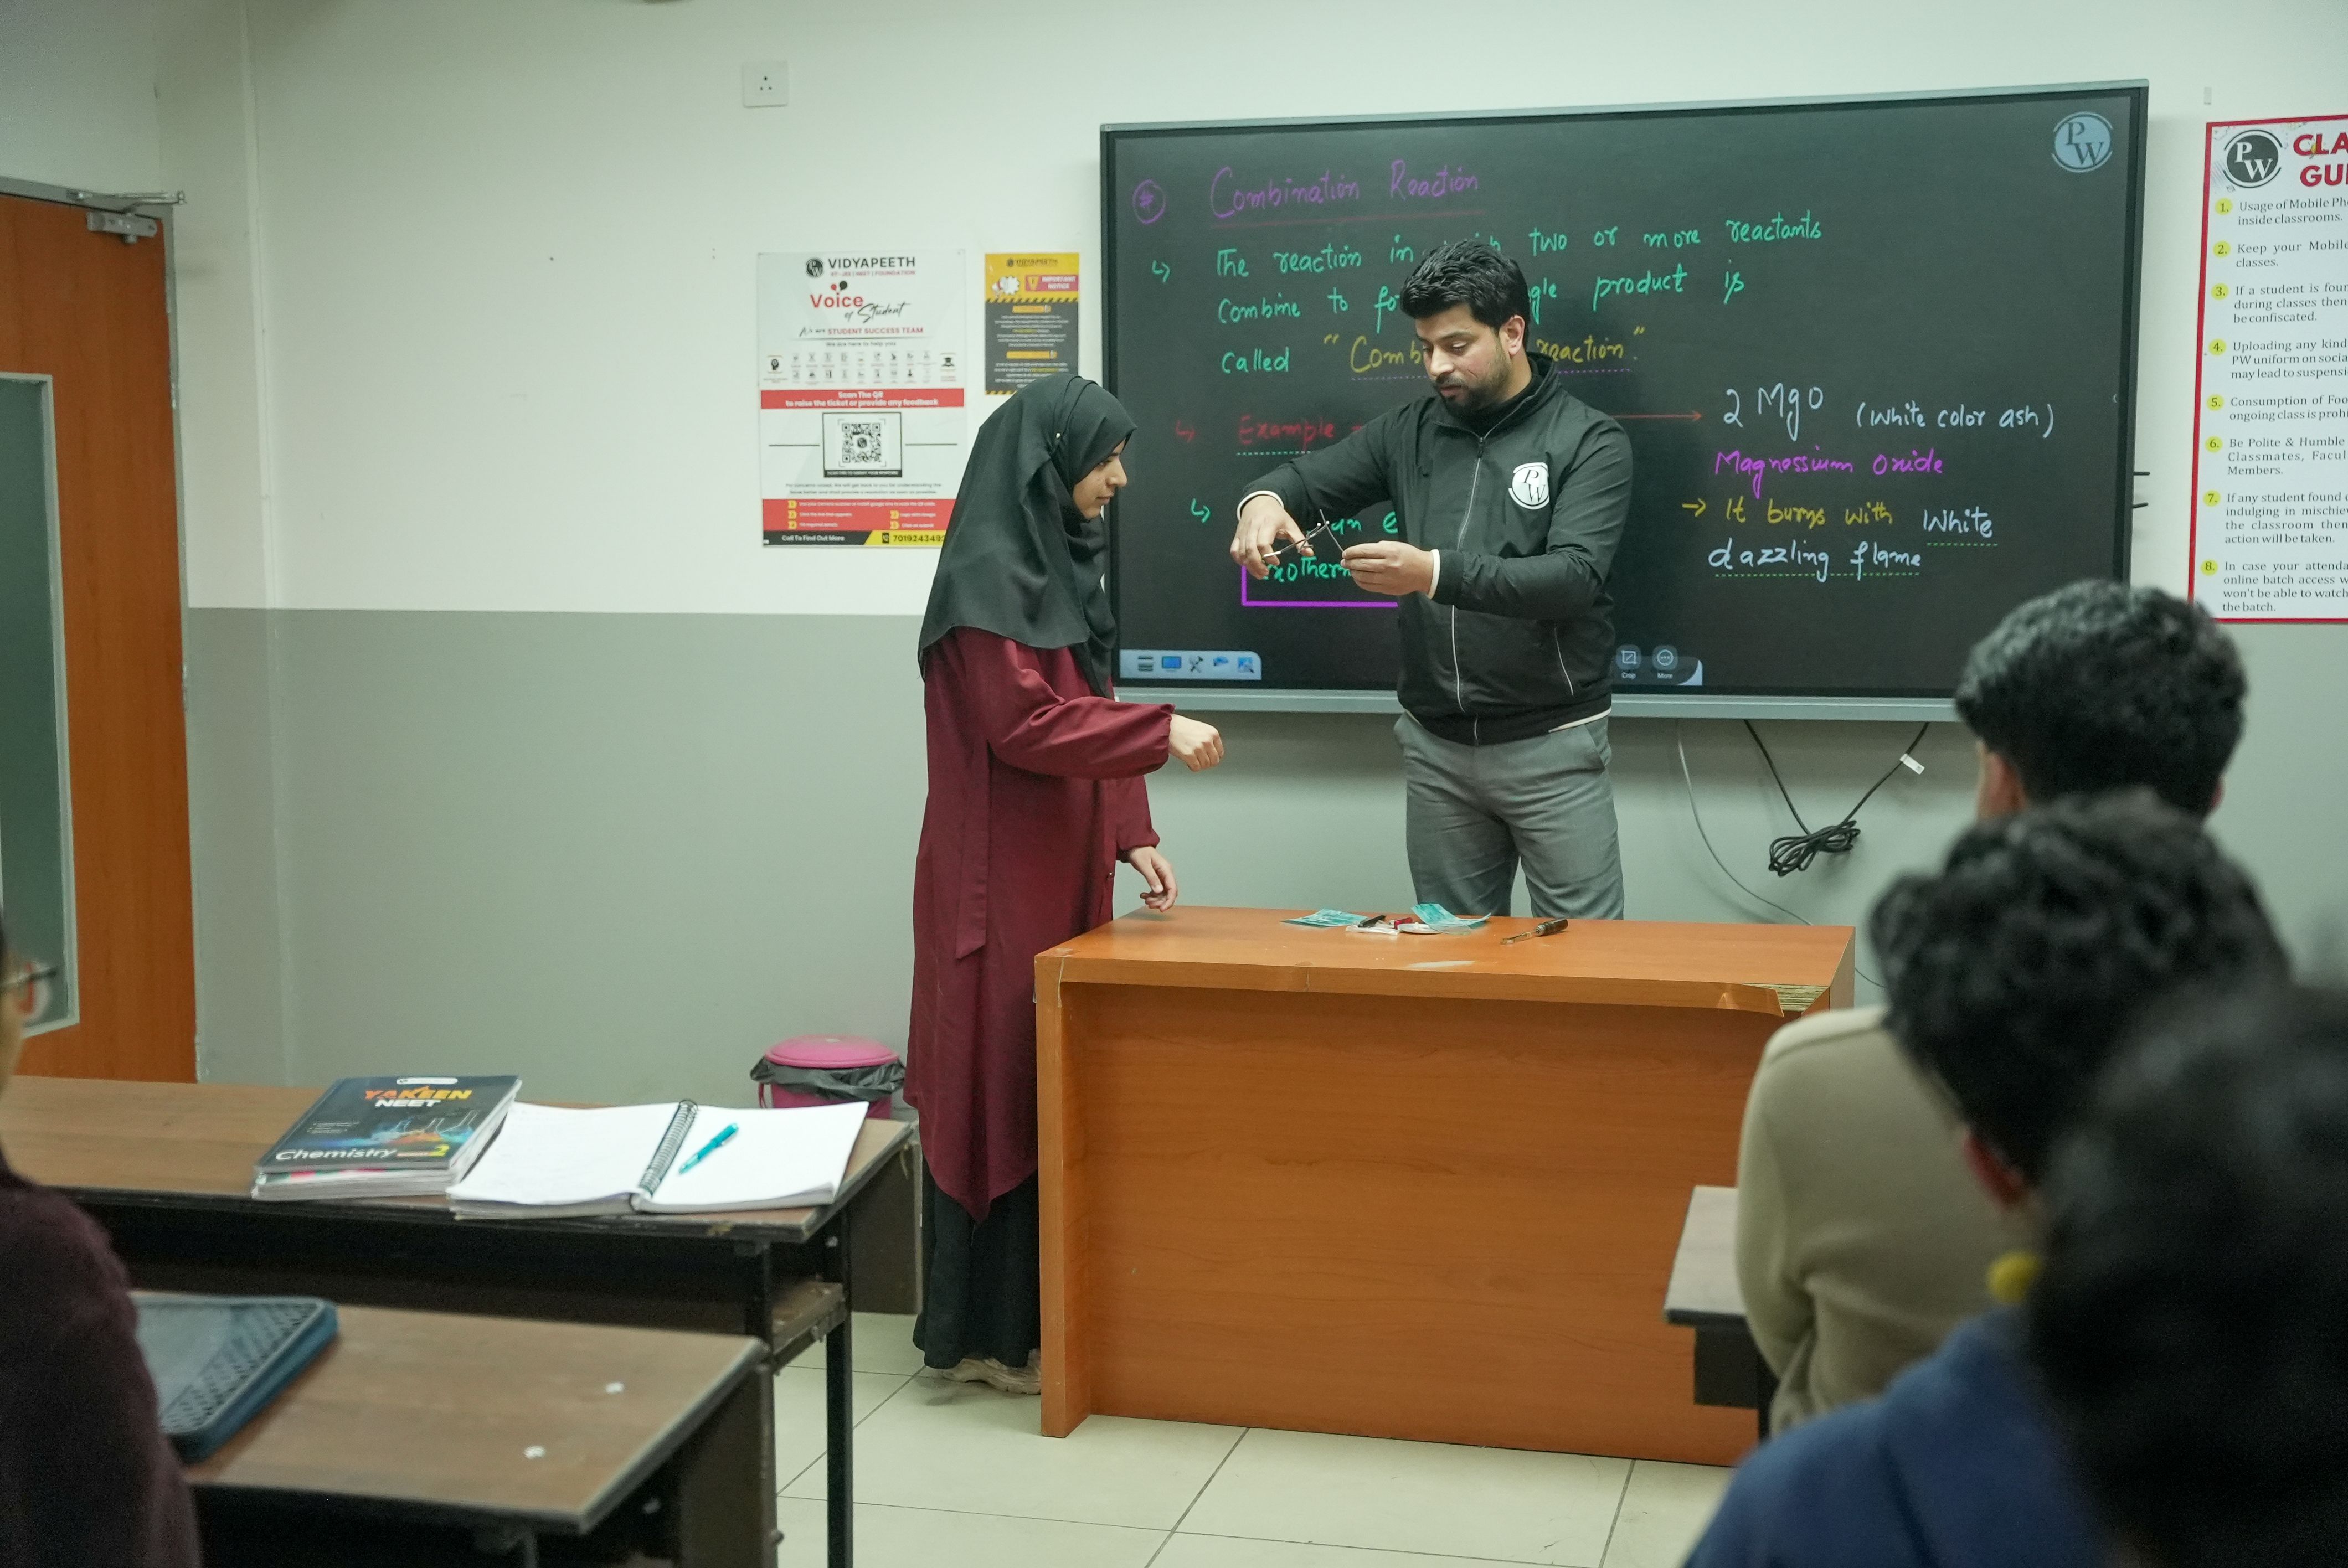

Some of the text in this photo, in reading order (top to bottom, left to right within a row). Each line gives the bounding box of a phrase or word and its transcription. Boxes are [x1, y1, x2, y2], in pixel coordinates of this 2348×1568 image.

[2234, 142, 2273, 180] PW
[1211, 159, 1478, 218] Combination Reaction
[2220, 197, 2348, 213] 1. Usage of Mobile Ph
[2238, 213, 2343, 225] inside classrooms.
[1217, 247, 1249, 277] The
[1273, 243, 1362, 274] reaction
[1389, 234, 1414, 263] in
[1594, 226, 1618, 246] or
[1644, 229, 1701, 249] more
[2217, 244, 2227, 255] 2.
[2238, 244, 2267, 255] Keep
[2273, 243, 2302, 254] your
[828, 257, 916, 269] VIDYAPEETH
[2236, 258, 2278, 267] classes.
[1328, 287, 1349, 313] to
[1592, 263, 1688, 312] product
[2215, 286, 2225, 297] 3.
[2236, 285, 2245, 295] If
[2260, 285, 2304, 295] student
[2310, 283, 2319, 292] is
[810, 292, 863, 308] Voice
[2234, 296, 2347, 311] during classes then
[2234, 311, 2317, 323] be confiscated.
[2213, 338, 2347, 353] 4. Uploading any kind
[2232, 355, 2251, 365] PW
[2253, 353, 2299, 365] uniform
[2232, 367, 2348, 381] may lead to suspensi
[858, 399, 887, 409] provide
[2211, 398, 2221, 408] 5.
[2231, 396, 2308, 408] Consumption
[2312, 395, 2324, 404] of
[2230, 409, 2316, 422] ongoing class is
[1237, 414, 1335, 451] Example
[2210, 436, 2345, 448] 6. Be Polite & Humble
[2228, 451, 2304, 462] Classmates,
[2228, 465, 2283, 475] Members.
[2207, 493, 2217, 503] 7.
[2227, 493, 2238, 502] If
[2238, 494, 2258, 504] any
[2261, 492, 2305, 502] student
[2309, 492, 2341, 502] found
[1726, 496, 1746, 523] It
[1845, 501, 1893, 524] with
[2226, 507, 2279, 518] indulging
[2285, 506, 2295, 515] in
[2226, 520, 2244, 529] the
[2251, 519, 2314, 529] classroom
[2225, 533, 2335, 544] action will be taken.
[1708, 537, 1830, 584] dazzling
[2205, 561, 2215, 571] 8.
[2225, 561, 2236, 570] In
[2273, 563, 2299, 572] your
[2223, 574, 2335, 584] online batch access
[2223, 589, 2254, 598] won't
[2258, 588, 2270, 598] be
[2274, 588, 2298, 597] able
[2300, 589, 2311, 597] to
[2223, 602, 2276, 612] the batch.
[364, 1085, 472, 1100] YAKEEN
[275, 1148, 398, 1161] Chemistry
[429, 1144, 450, 1157] 2
